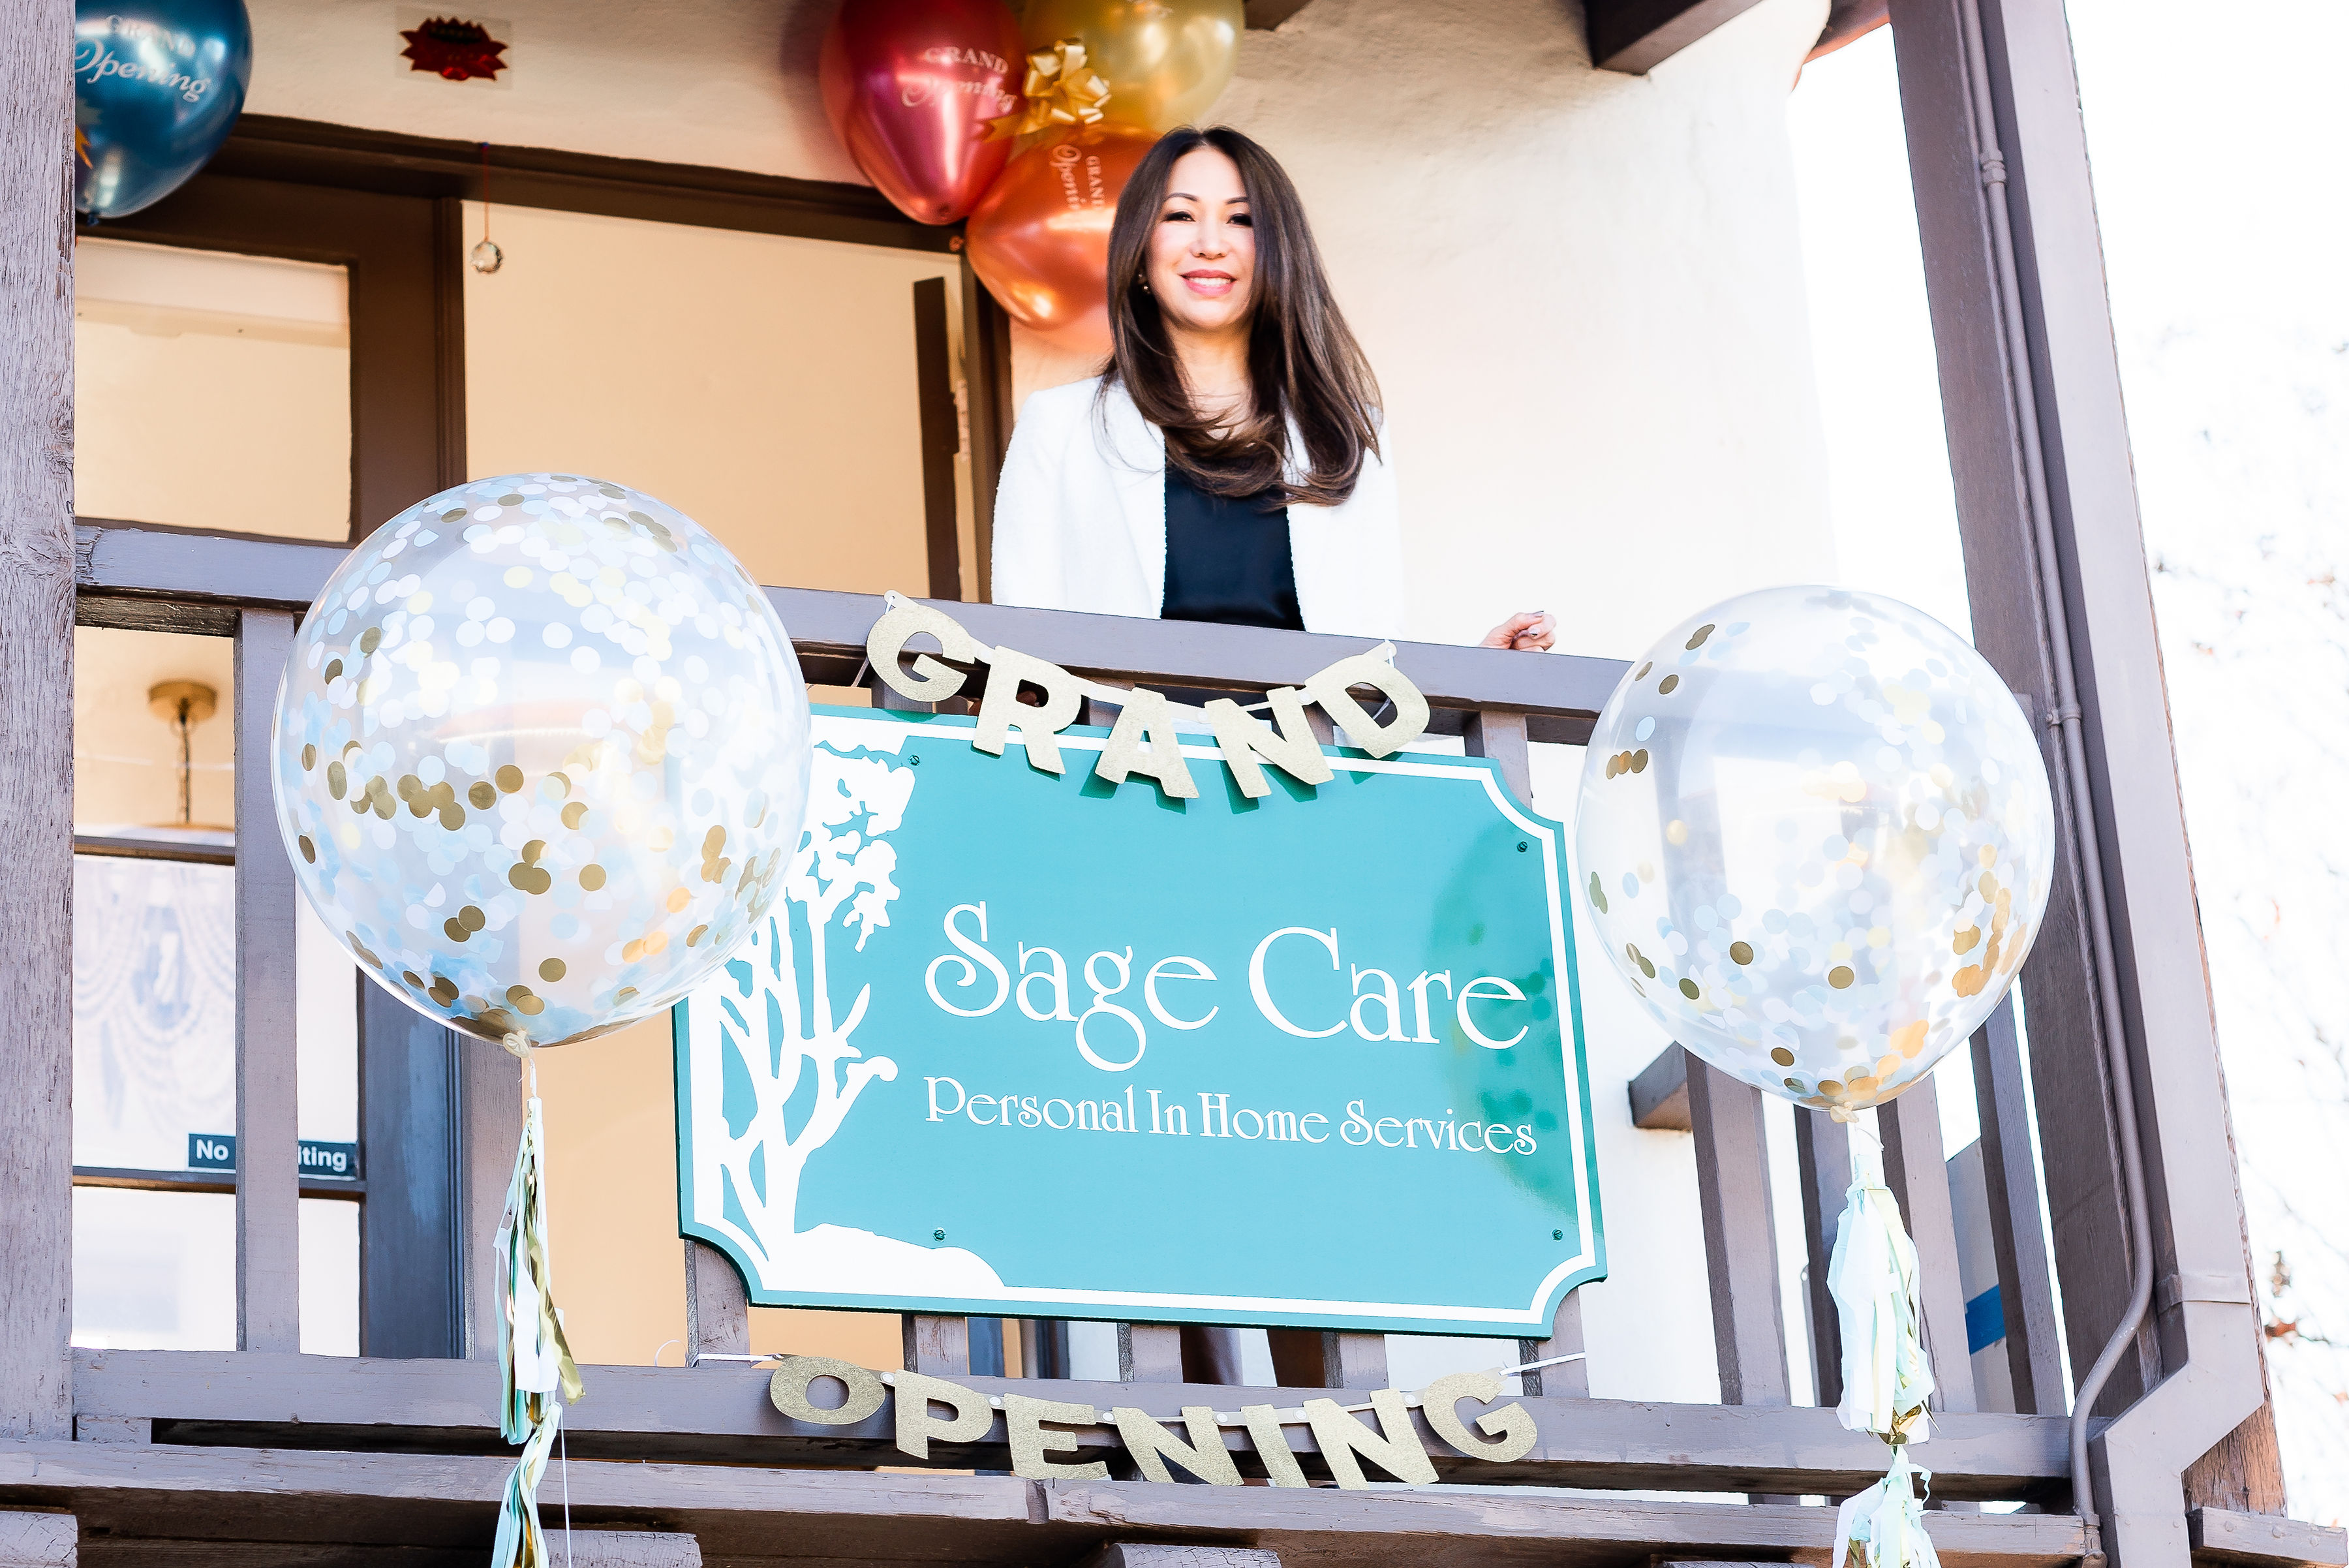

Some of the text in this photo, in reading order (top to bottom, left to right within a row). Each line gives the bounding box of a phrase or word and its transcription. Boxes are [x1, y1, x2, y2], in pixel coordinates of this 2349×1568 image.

[925, 46, 1009, 75] GRAND
[867, 604, 1432, 799] GRAND
[924, 900, 1530, 1072] Sage Care
[196, 1139, 229, 1161] No
[923, 1075, 1537, 1156] Personal In Home Services
[769, 1355, 1538, 1490] OPENING
